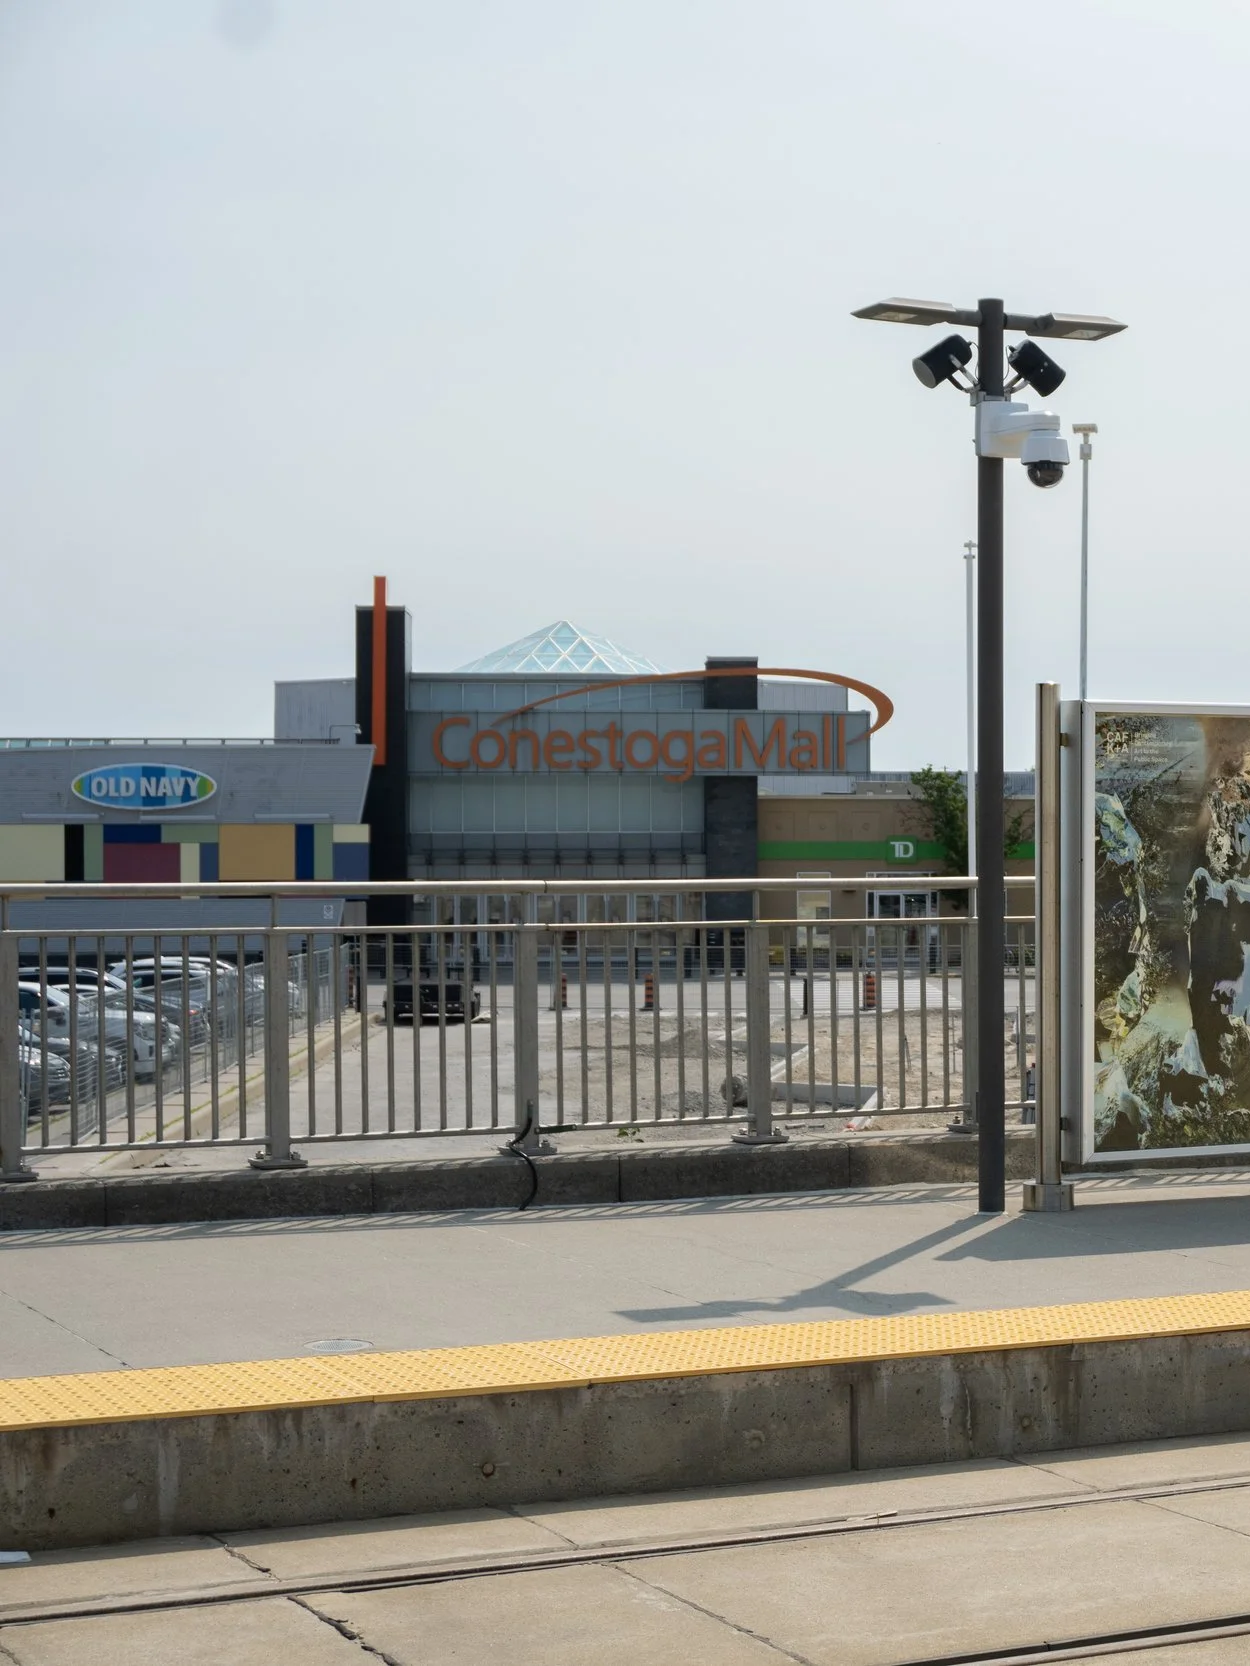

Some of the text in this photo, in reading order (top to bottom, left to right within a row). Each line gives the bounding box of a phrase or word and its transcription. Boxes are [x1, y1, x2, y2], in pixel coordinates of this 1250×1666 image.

[91, 776, 200, 797] OLD NAVY
[890, 841, 914, 858] TD
